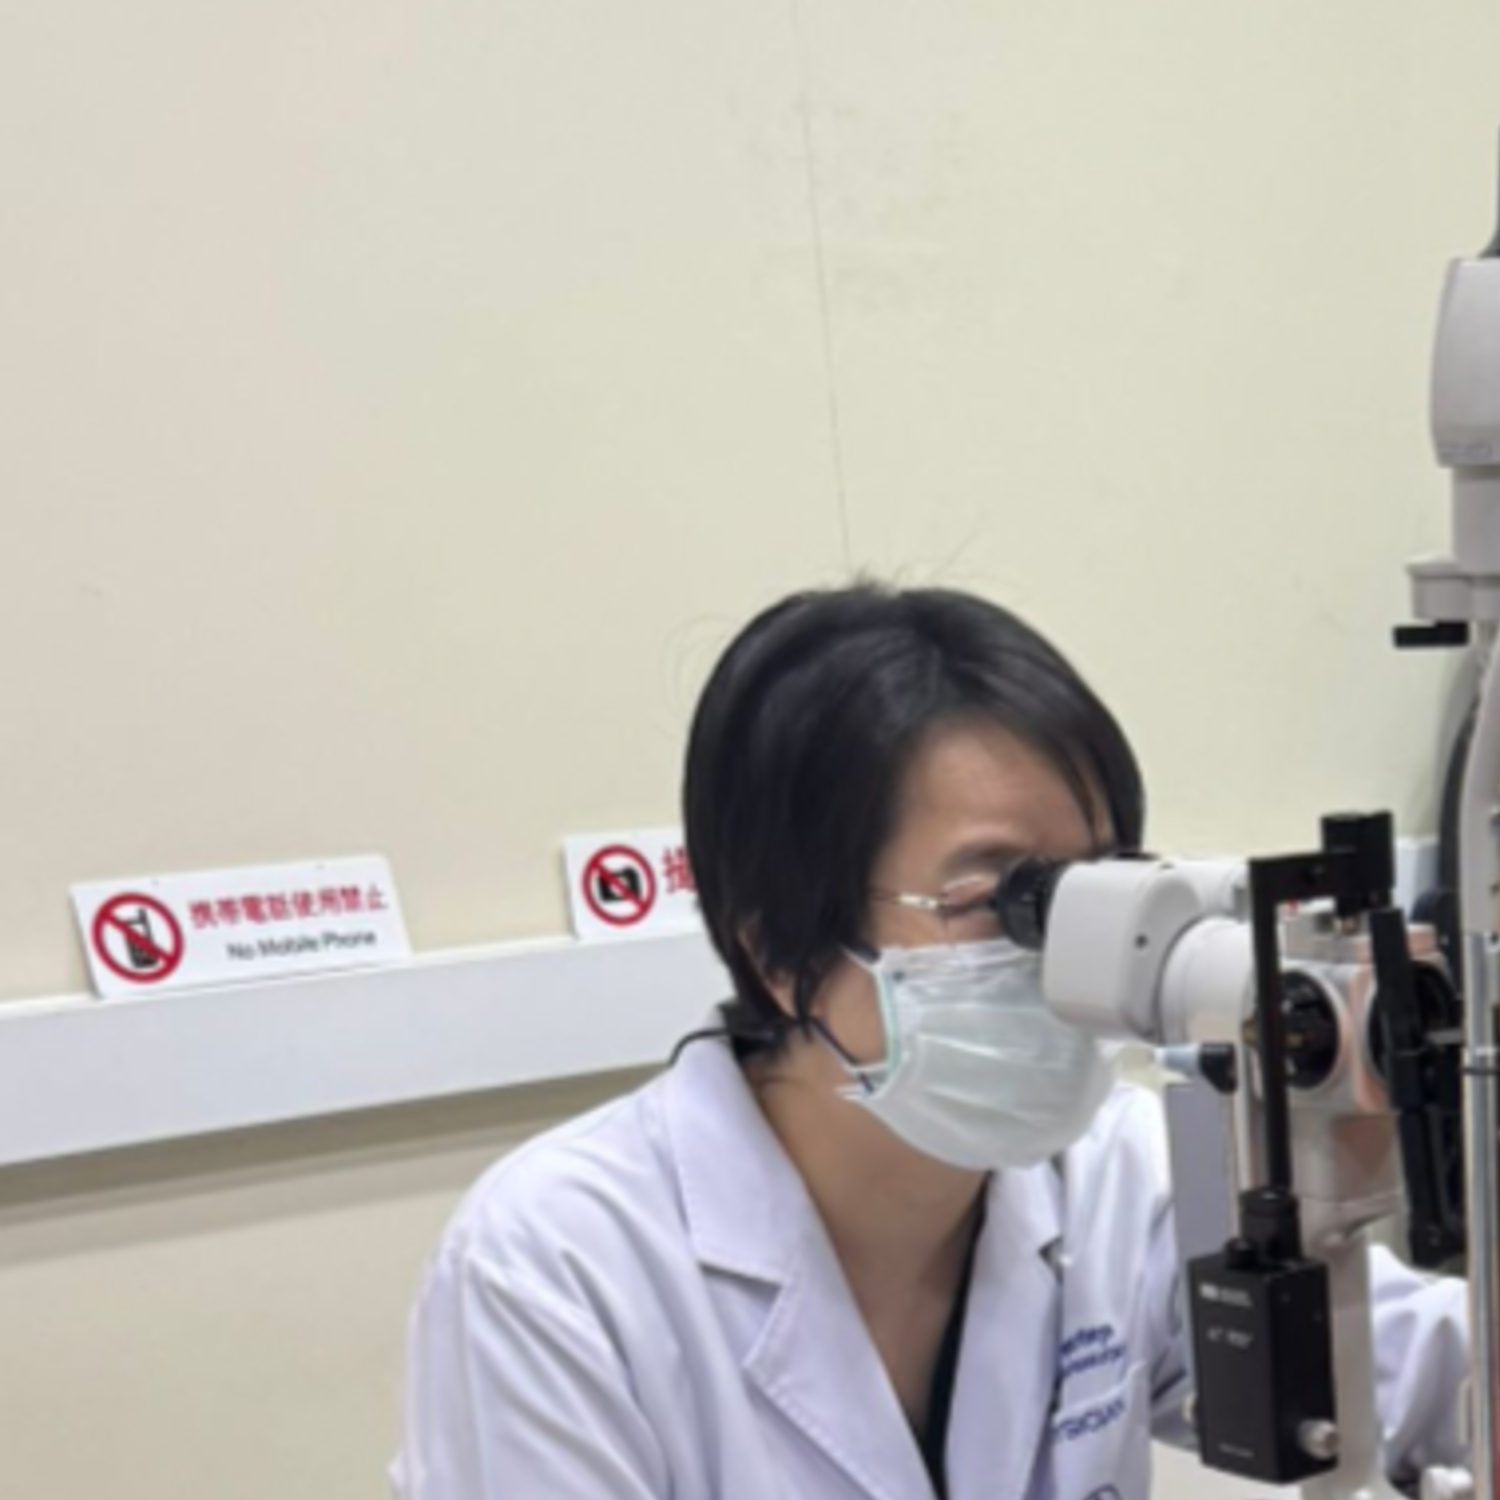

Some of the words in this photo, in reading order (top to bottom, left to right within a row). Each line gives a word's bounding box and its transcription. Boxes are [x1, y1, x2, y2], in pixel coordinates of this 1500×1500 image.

[226, 942, 255, 960] No
[258, 935, 320, 957] Mobile
[322, 930, 376, 949] Phone
